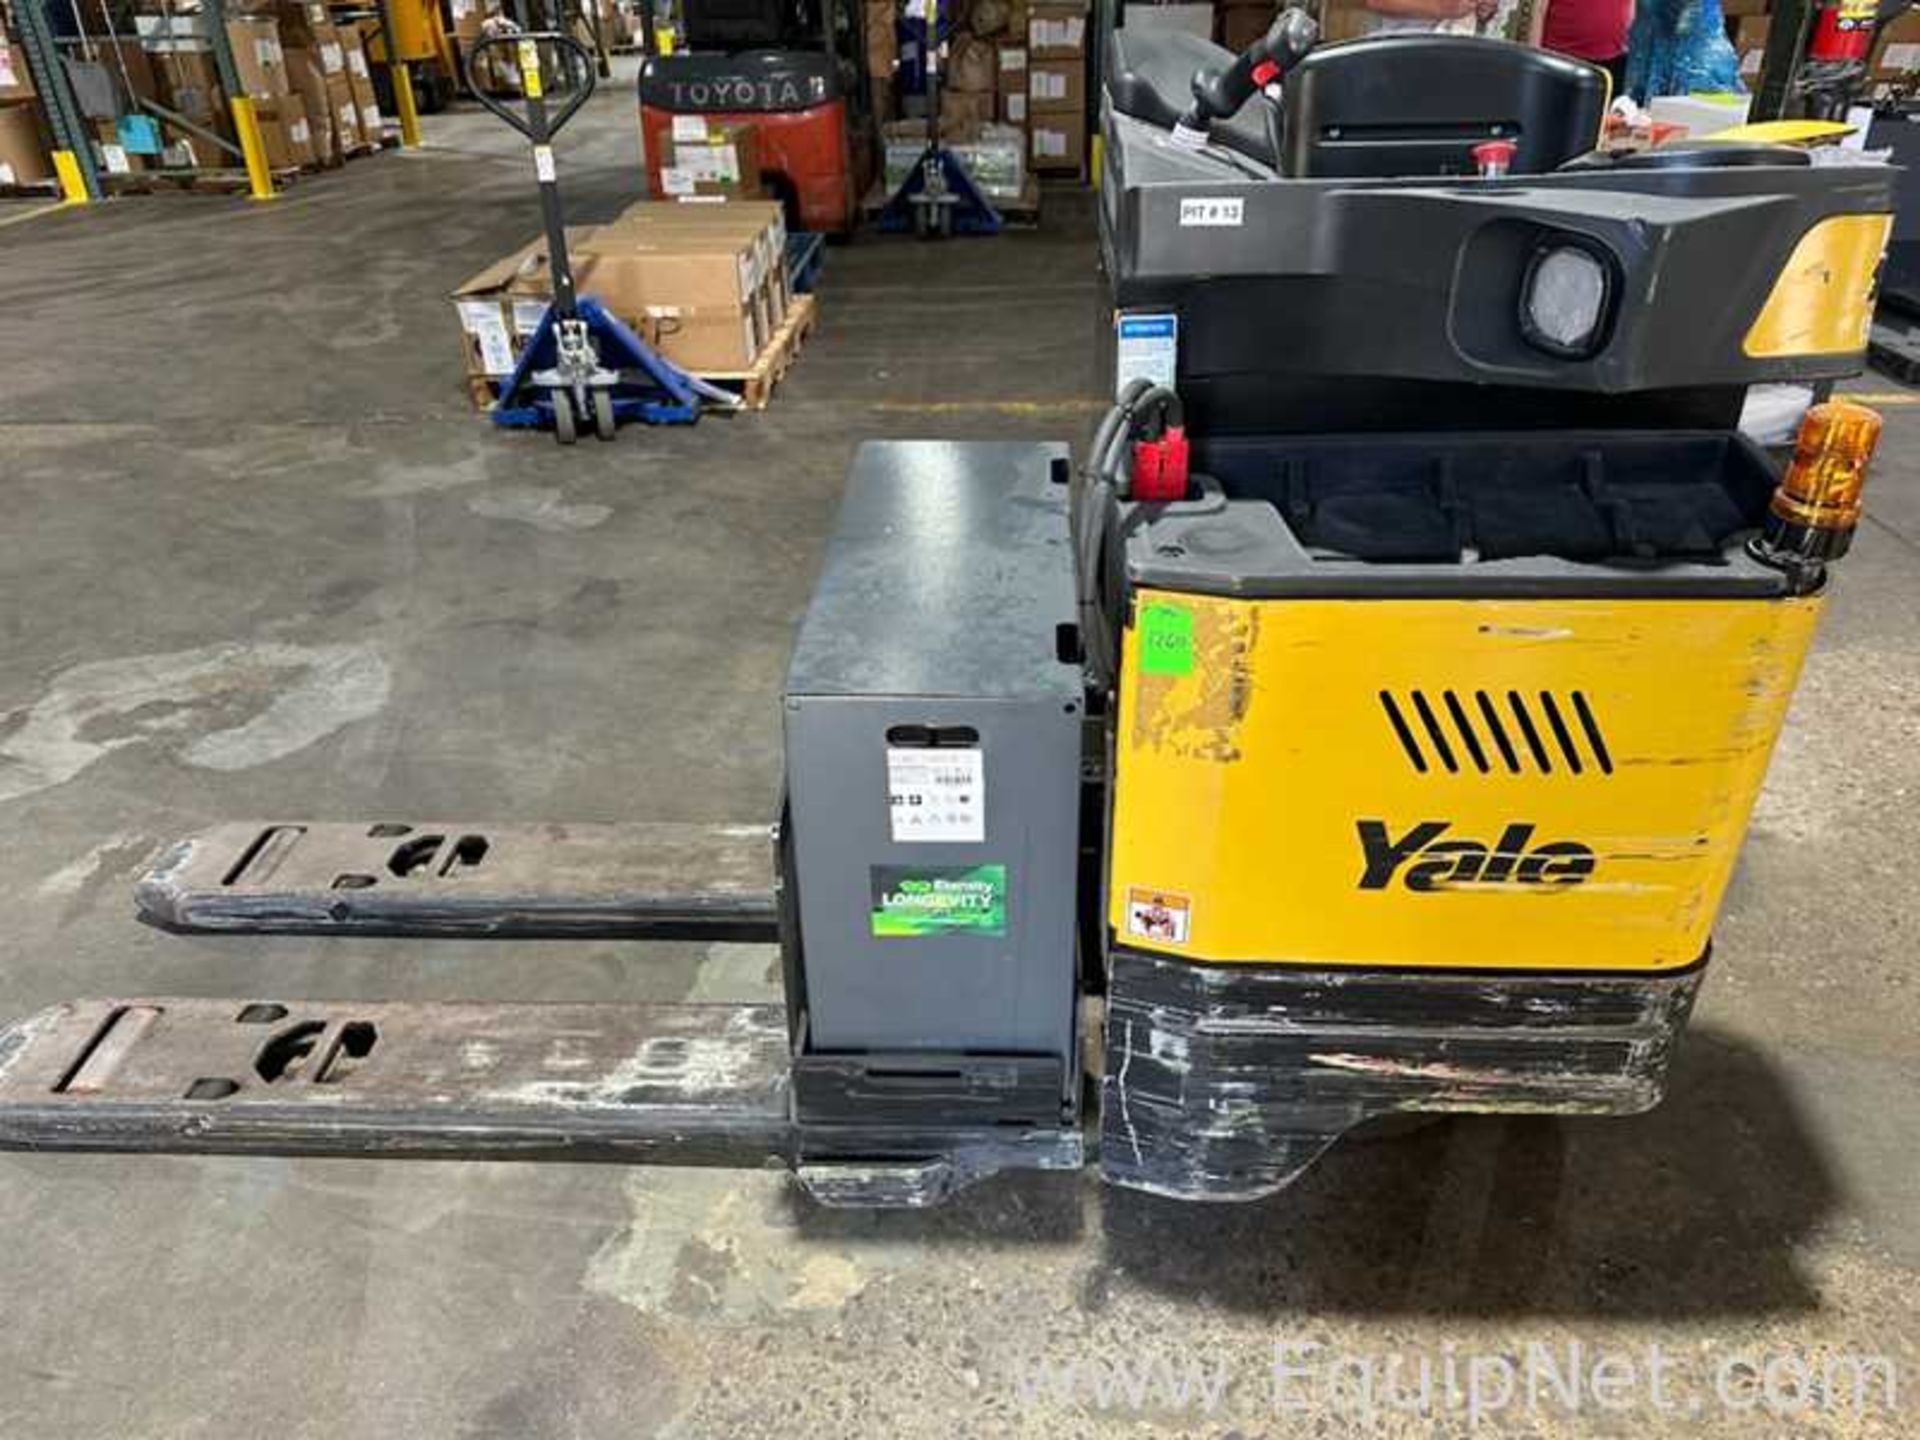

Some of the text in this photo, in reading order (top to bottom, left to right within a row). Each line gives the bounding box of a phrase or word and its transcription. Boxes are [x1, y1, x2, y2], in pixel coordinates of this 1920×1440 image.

[669, 82, 799, 105] TOYOTA
[1182, 204, 1205, 219] PIT
[1356, 820, 1596, 891] Yale
[882, 892, 992, 908] LONGEVITY
